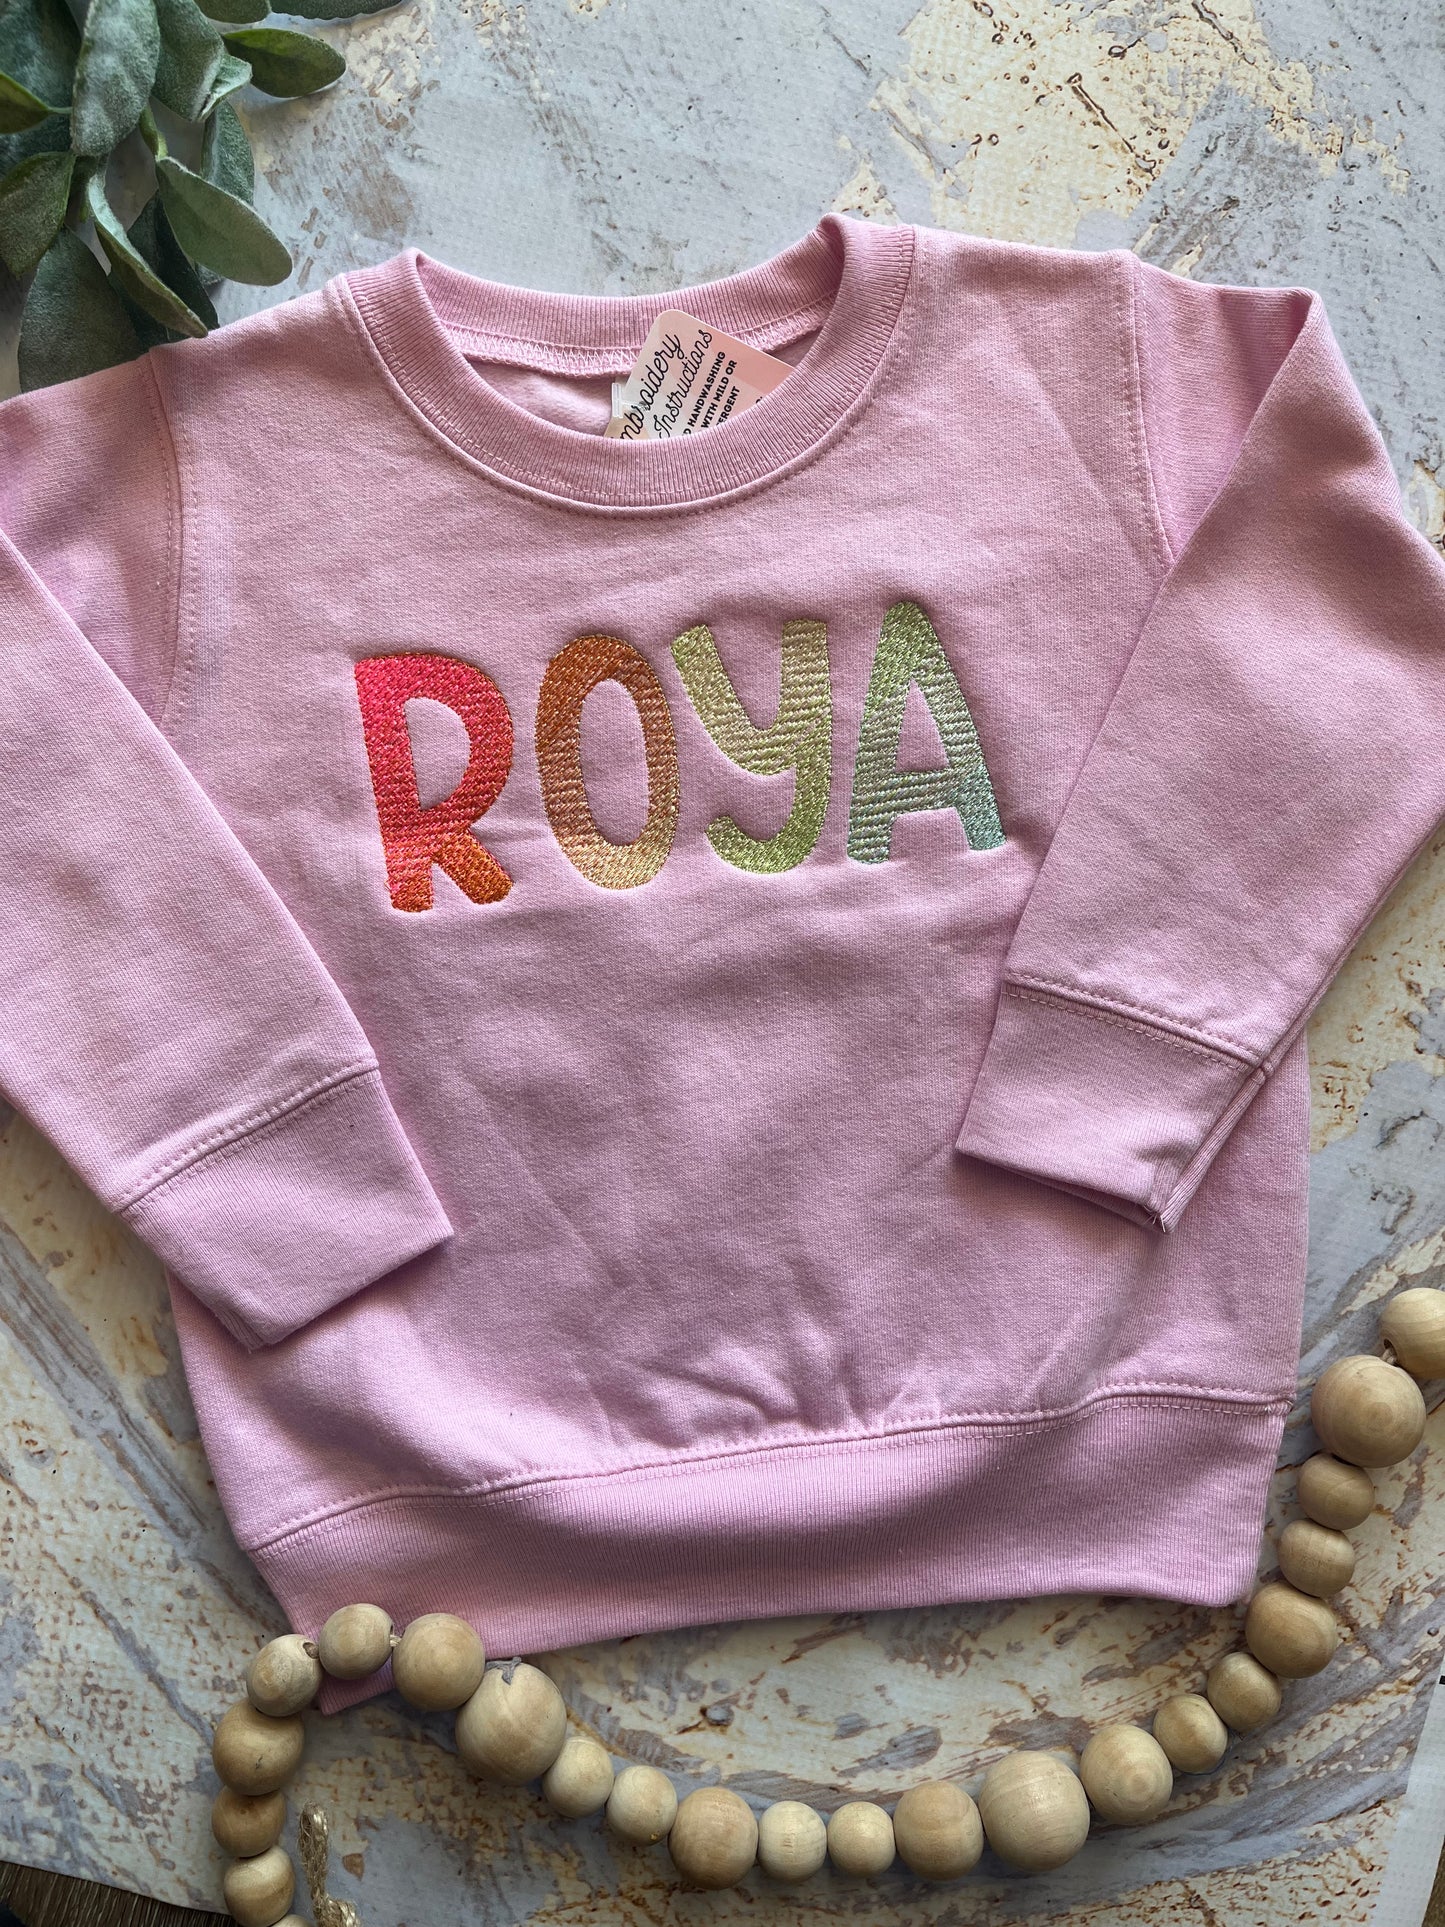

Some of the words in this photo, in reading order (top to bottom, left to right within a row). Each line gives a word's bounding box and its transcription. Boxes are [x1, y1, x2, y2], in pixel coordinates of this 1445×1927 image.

[611, 334, 684, 439] mbroidery
[654, 329, 713, 438] Instructions
[687, 351, 726, 427] HANDWASHING
[701, 402, 718, 428] WITH
[713, 376, 729, 402] MILD
[725, 360, 737, 375] OR
[716, 386, 740, 425] ERGENT
[354, 600, 1007, 912] ROYA
